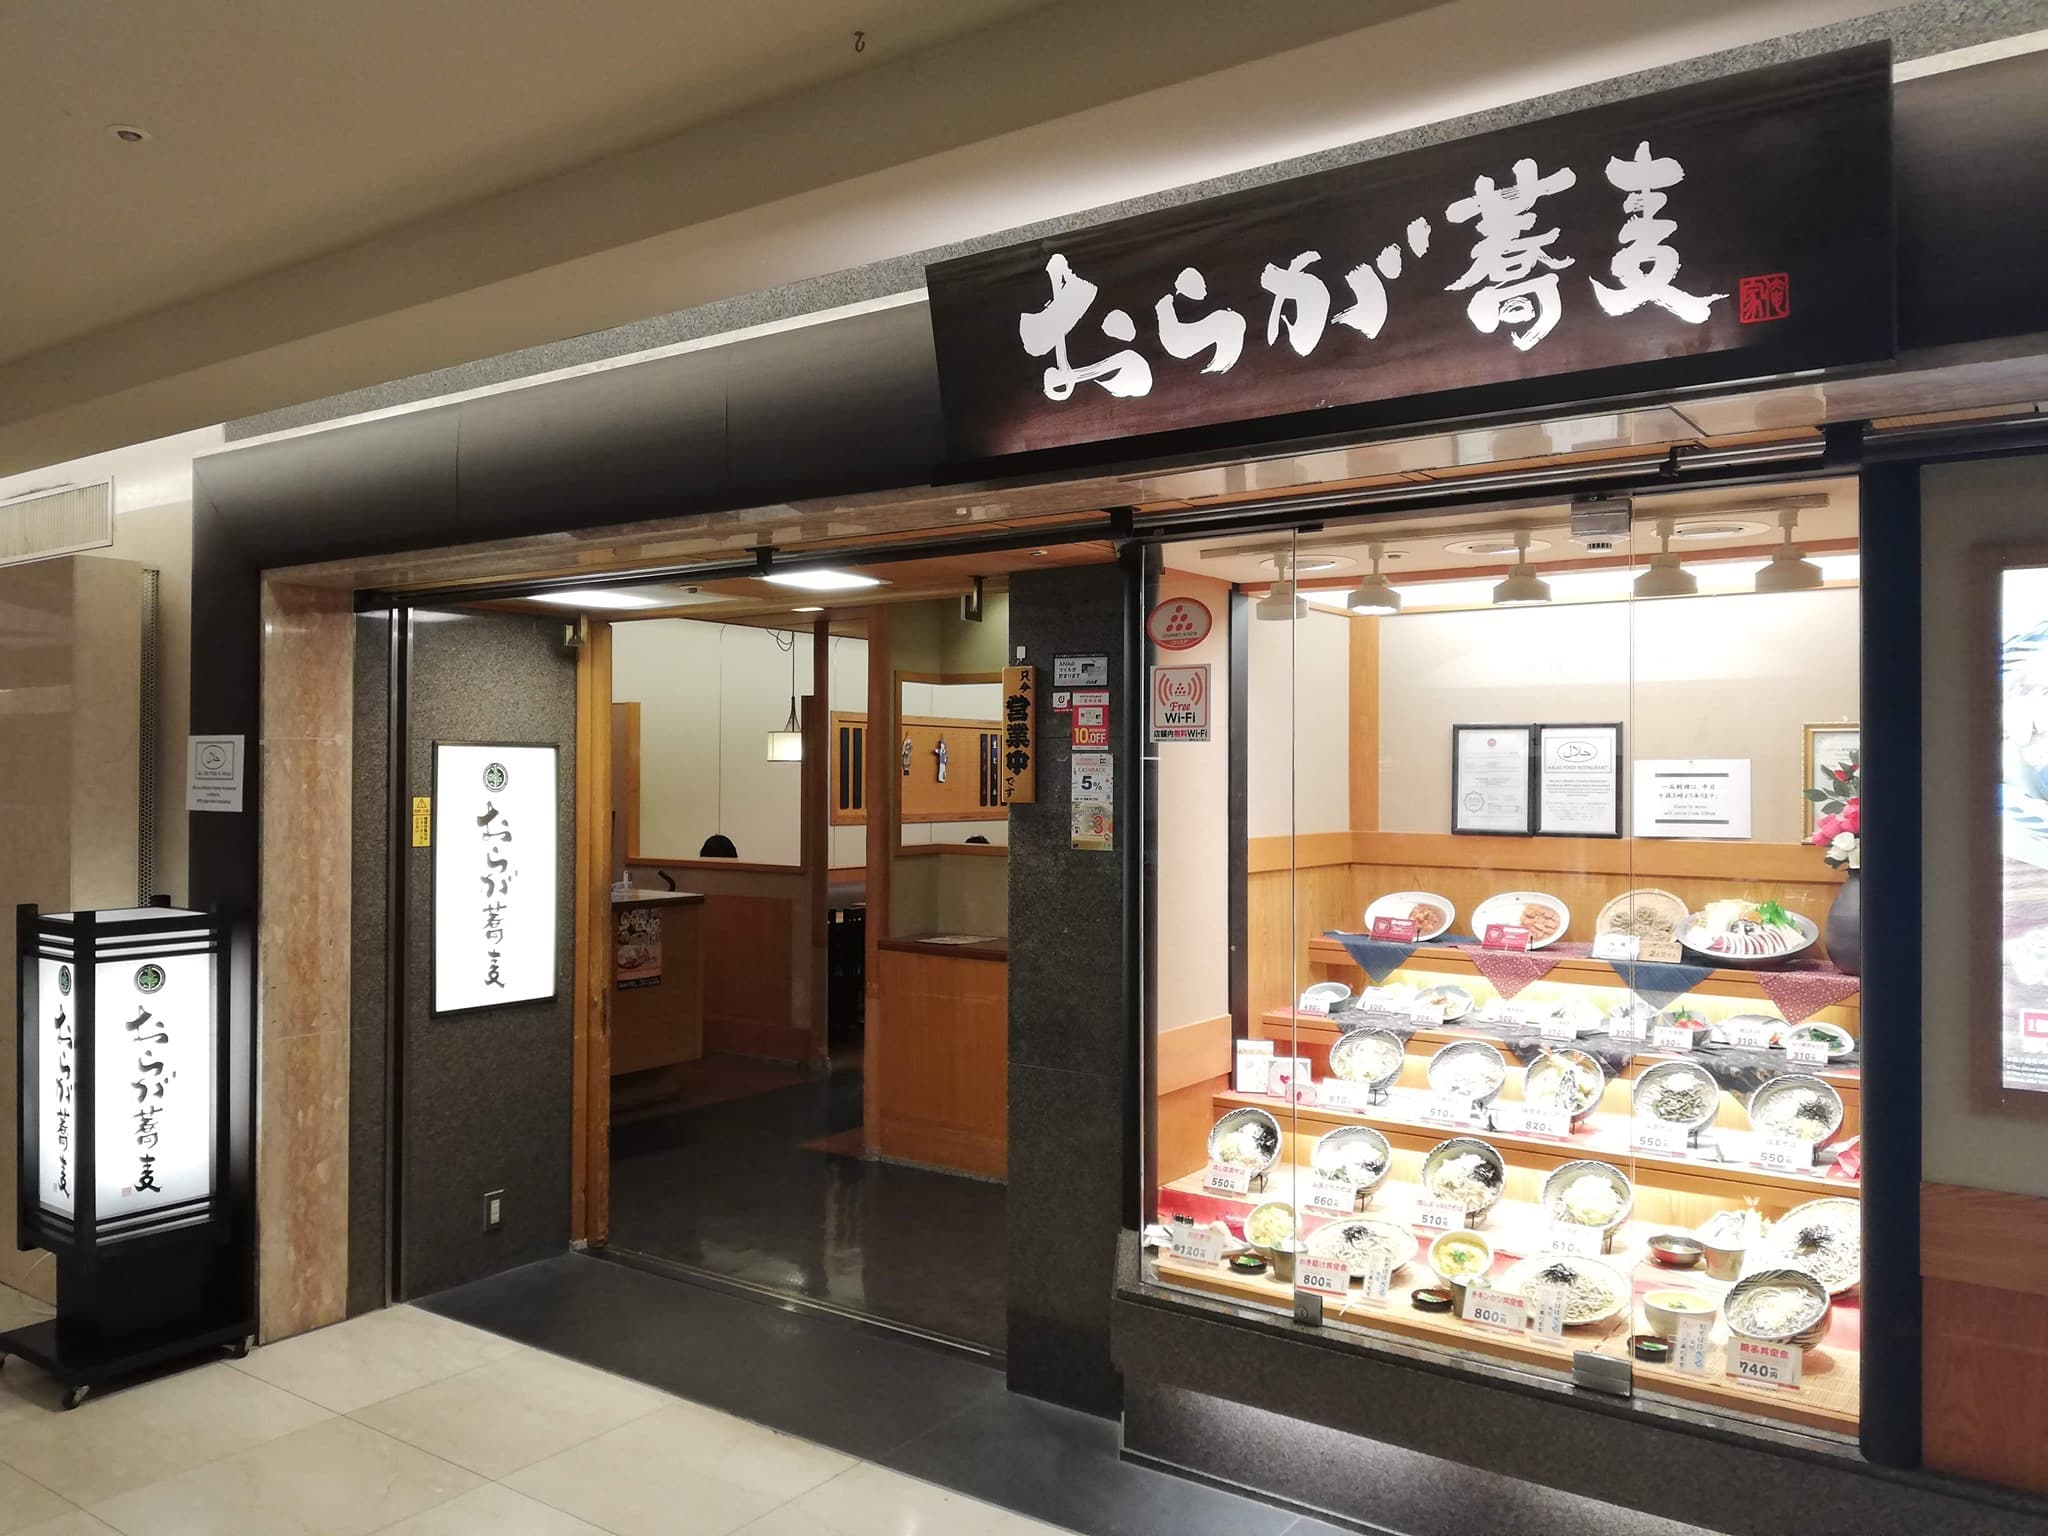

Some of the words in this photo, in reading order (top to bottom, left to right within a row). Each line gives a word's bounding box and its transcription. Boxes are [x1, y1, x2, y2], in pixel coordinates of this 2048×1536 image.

[1018, 140, 1729, 402] おらが蕎麦
[1169, 701, 1191, 711] Free
[1164, 712, 1196, 723] Wi-Fi
[1153, 729, 1208, 738] 店舗内無料Wi-Fi
[1081, 775, 1103, 791] 5%
[476, 800, 519, 989] おらが蕎麦
[54, 1003, 74, 1200] おらが蕎麦
[125, 1004, 177, 1194] おらが蕎麦
[1211, 1177, 1235, 1189] 550円
[1313, 1195, 1339, 1208] 660円
[1421, 1213, 1448, 1227] 510円
[1303, 1274, 1332, 1288] 800円
[1474, 1307, 1508, 1324] 800円
[1739, 1360, 1778, 1379] 740円
